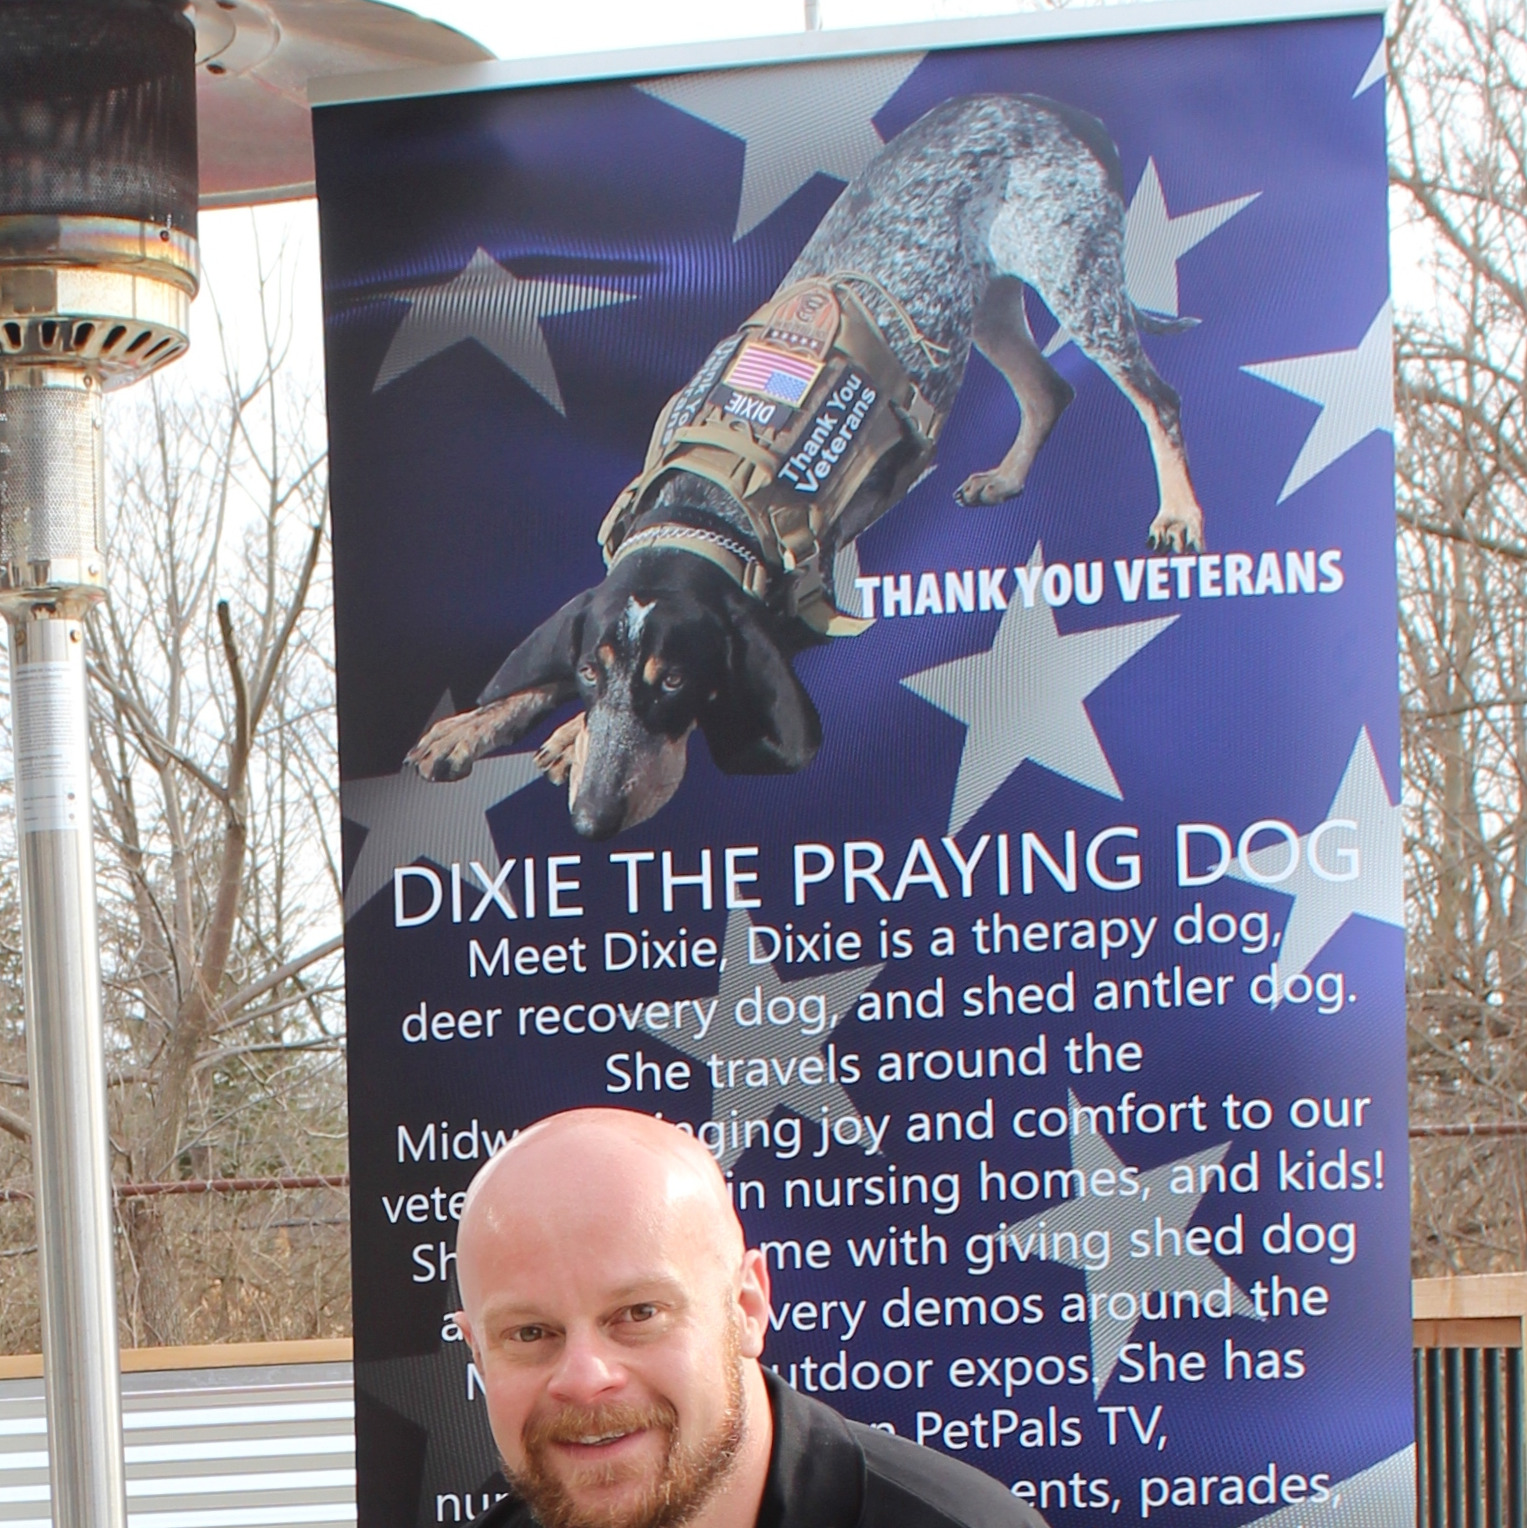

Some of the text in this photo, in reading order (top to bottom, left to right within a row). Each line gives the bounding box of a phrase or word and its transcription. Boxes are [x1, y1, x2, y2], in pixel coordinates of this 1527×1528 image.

[724, 390, 776, 425] DIXIE
[778, 372, 863, 484] Thank You
[794, 386, 877, 495] Veterans
[854, 550, 1345, 618] THANK YOU VETERANS
[392, 818, 1360, 928] DIXIE THE PRAYING DOG
[469, 902, 1282, 978] Meet Dixie, Dixie is a therapy dog,
[402, 961, 1358, 1043] deer recovery dog, and shed antler dog.
[606, 1031, 1144, 1094] She travels around the
[397, 1119, 520, 1163] Midw
[813, 1106, 891, 1155] joy
[906, 1099, 995, 1143] and
[1012, 1092, 1208, 1136] comfort
[1223, 1092, 1273, 1131] to
[1289, 1095, 1372, 1129] our
[381, 1186, 467, 1224] vete
[784, 1165, 961, 1215] nursing
[979, 1160, 1152, 1202] homes,
[1169, 1150, 1260, 1195] and
[1277, 1149, 1386, 1192] kids!
[412, 1212, 1357, 1282] Sh me with giving shed dog
[767, 1275, 1330, 1341] very demos around the
[772, 1350, 934, 1393] utdoor
[1118, 1341, 1207, 1384] She
[1224, 1338, 1307, 1381] has
[916, 1404, 1168, 1451] PetPals TV,
[1010, 1463, 1342, 1518] ents, parades,
